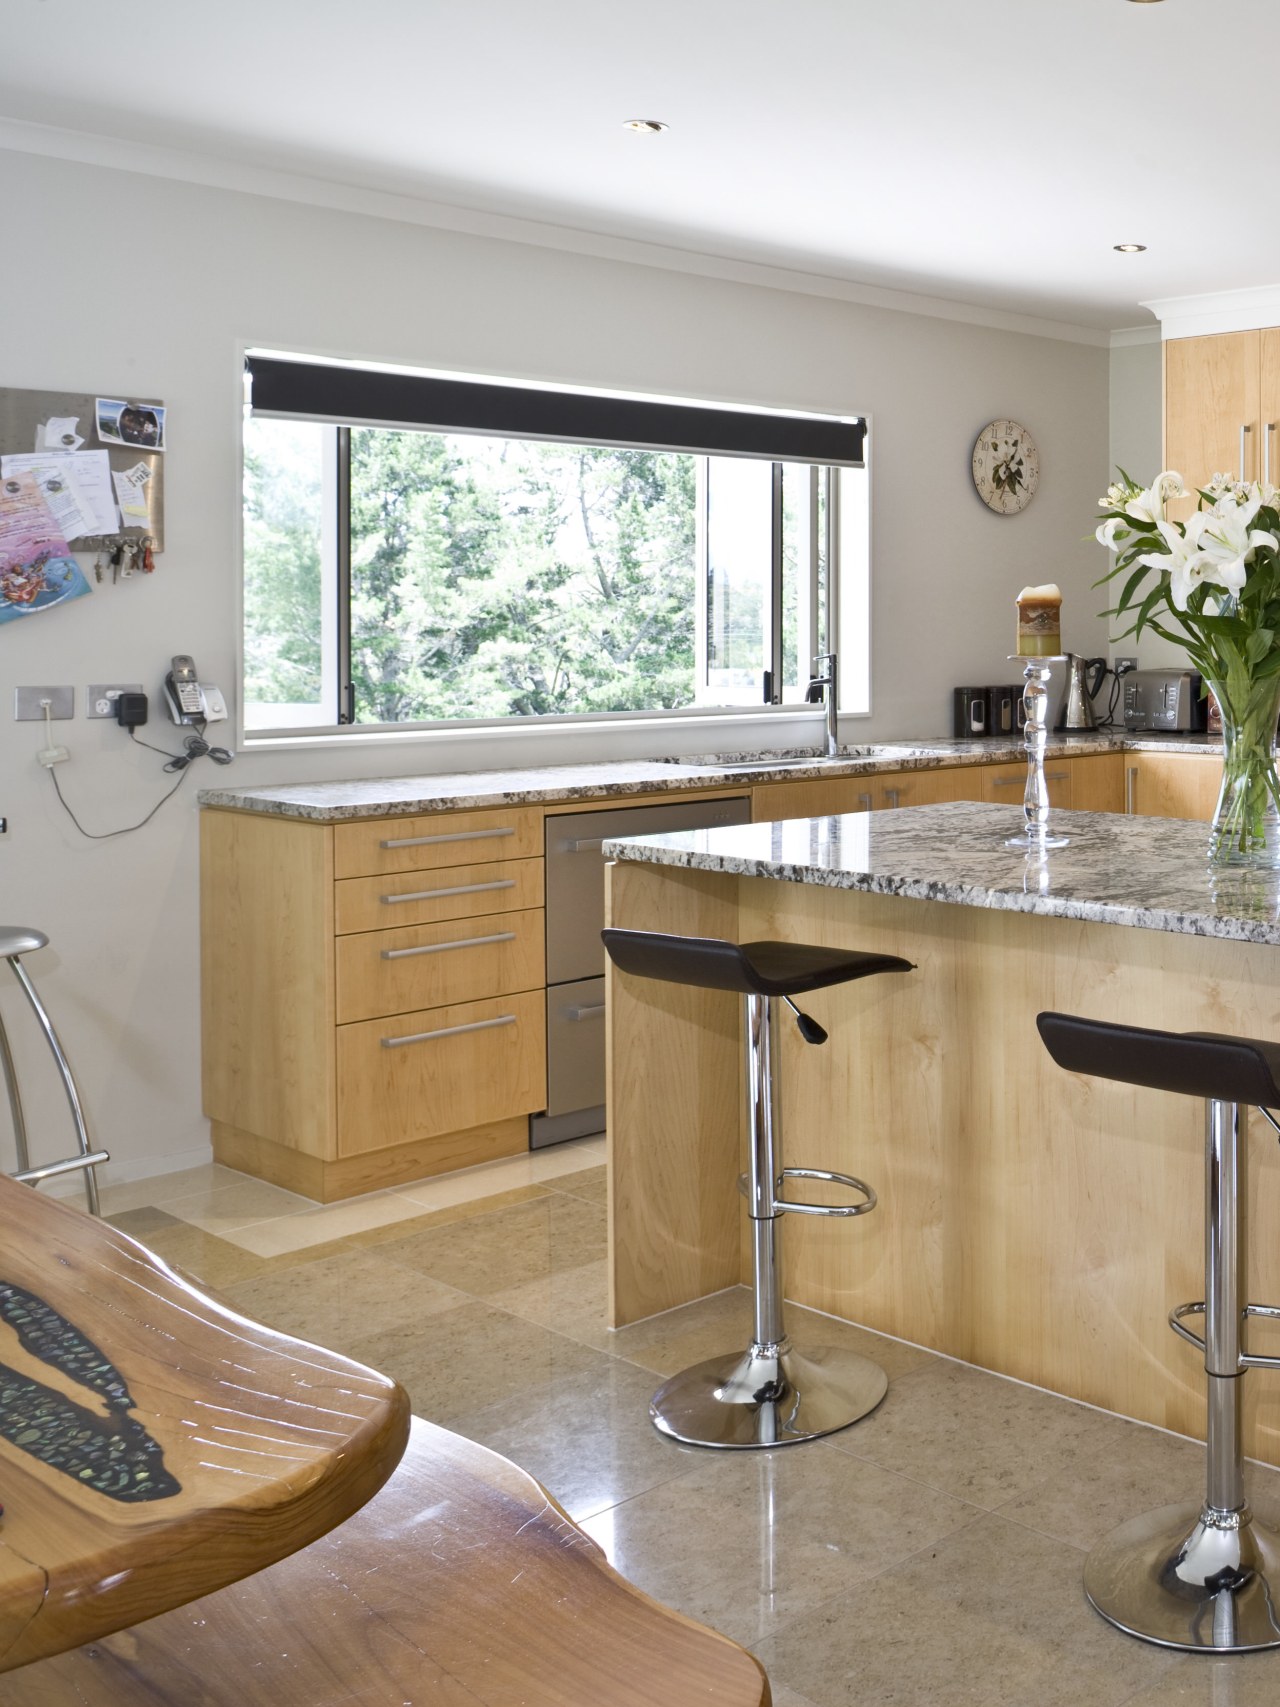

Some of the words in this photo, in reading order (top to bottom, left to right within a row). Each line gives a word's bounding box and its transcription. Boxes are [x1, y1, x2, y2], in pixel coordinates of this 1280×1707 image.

[991, 428, 998, 439] 11
[1005, 425, 1013, 436] 12
[981, 441, 989, 451] 10
[1026, 448, 1032, 458] 2
[978, 458, 983, 468] 9
[1030, 468, 1035, 478] 3
[980, 477, 986, 486] 8
[1002, 499, 1007, 509] 6
